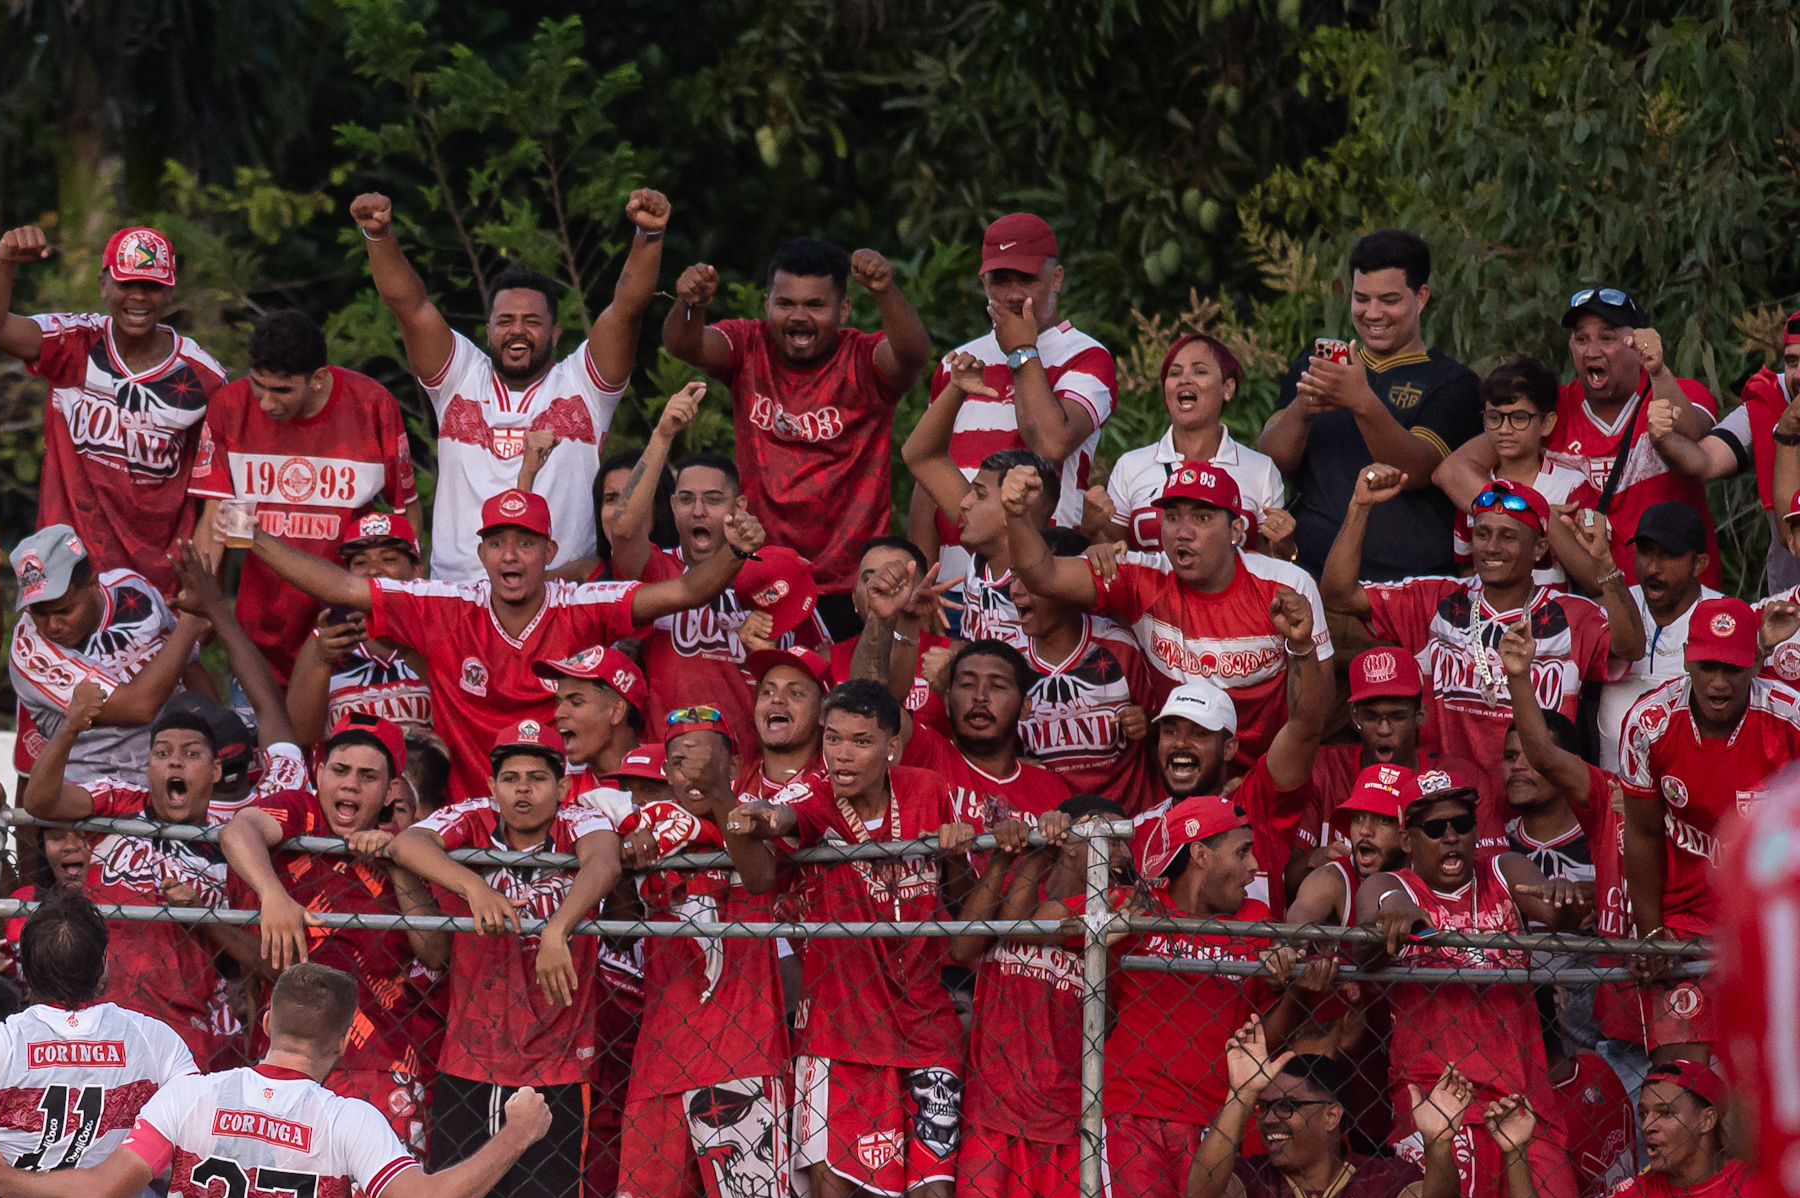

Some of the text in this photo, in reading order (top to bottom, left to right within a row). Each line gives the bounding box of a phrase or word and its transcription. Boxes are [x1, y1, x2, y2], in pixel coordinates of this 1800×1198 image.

[244, 461, 356, 501] 19 93
[1175, 695, 1206, 706] Supreme
[33, 1044, 120, 1064] CORINGA
[219, 1113, 305, 1147] CORINGA
[861, 1146, 892, 1167] CRB
